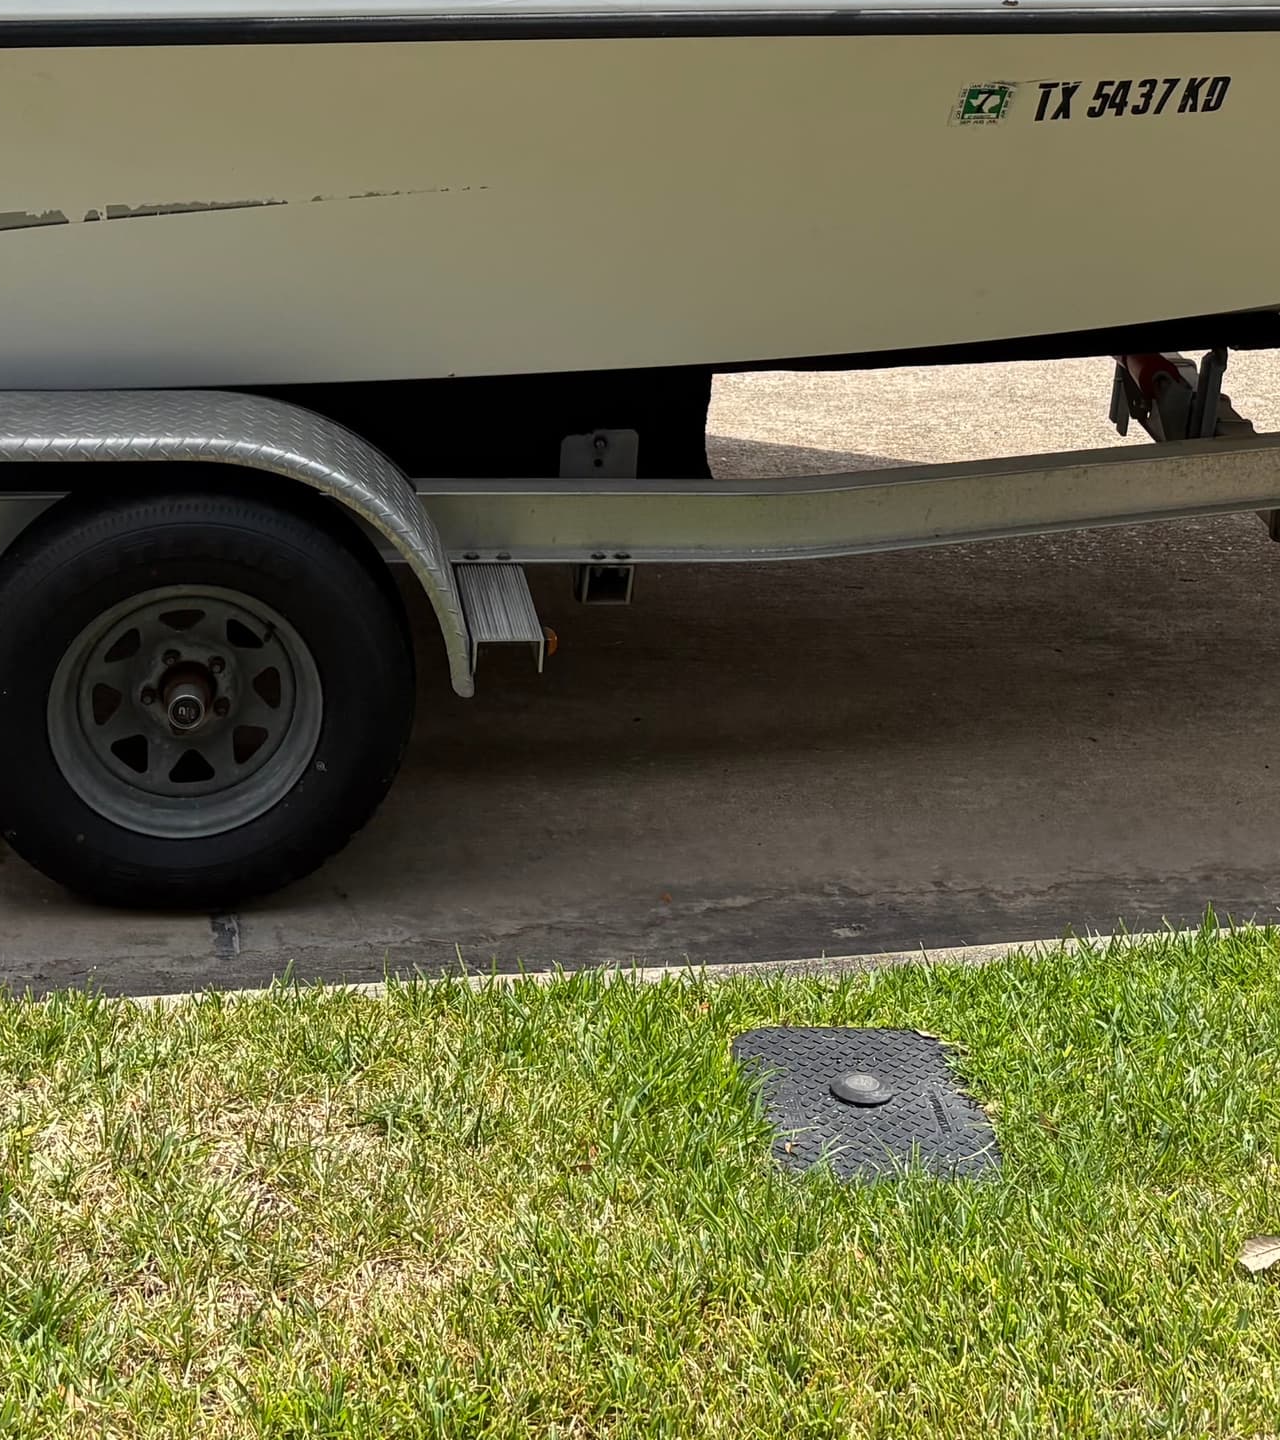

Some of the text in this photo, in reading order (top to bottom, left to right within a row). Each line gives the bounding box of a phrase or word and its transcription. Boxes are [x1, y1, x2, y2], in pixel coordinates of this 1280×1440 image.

[1034, 76, 1231, 121] TX 5437 KD
